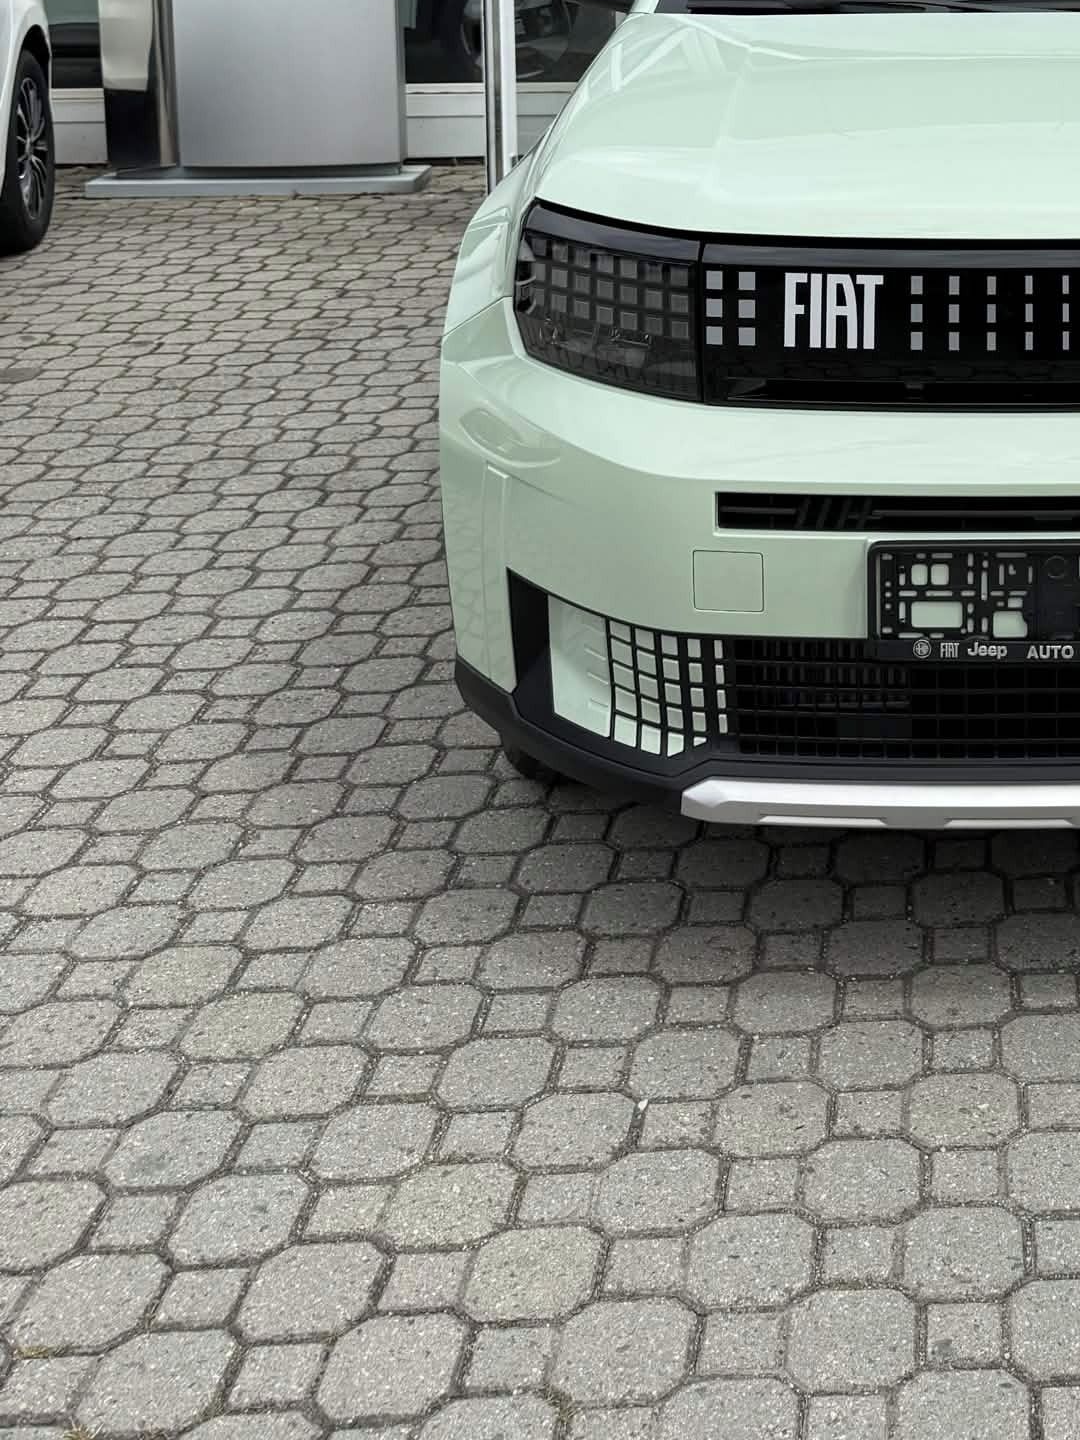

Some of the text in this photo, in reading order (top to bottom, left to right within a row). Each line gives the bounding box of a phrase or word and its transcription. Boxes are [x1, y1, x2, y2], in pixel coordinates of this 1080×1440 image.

[784, 272, 884, 350] FIAT
[940, 642, 960, 659] FIAT
[967, 641, 1008, 660] Jeep
[1026, 645, 1075, 659] AUTO
